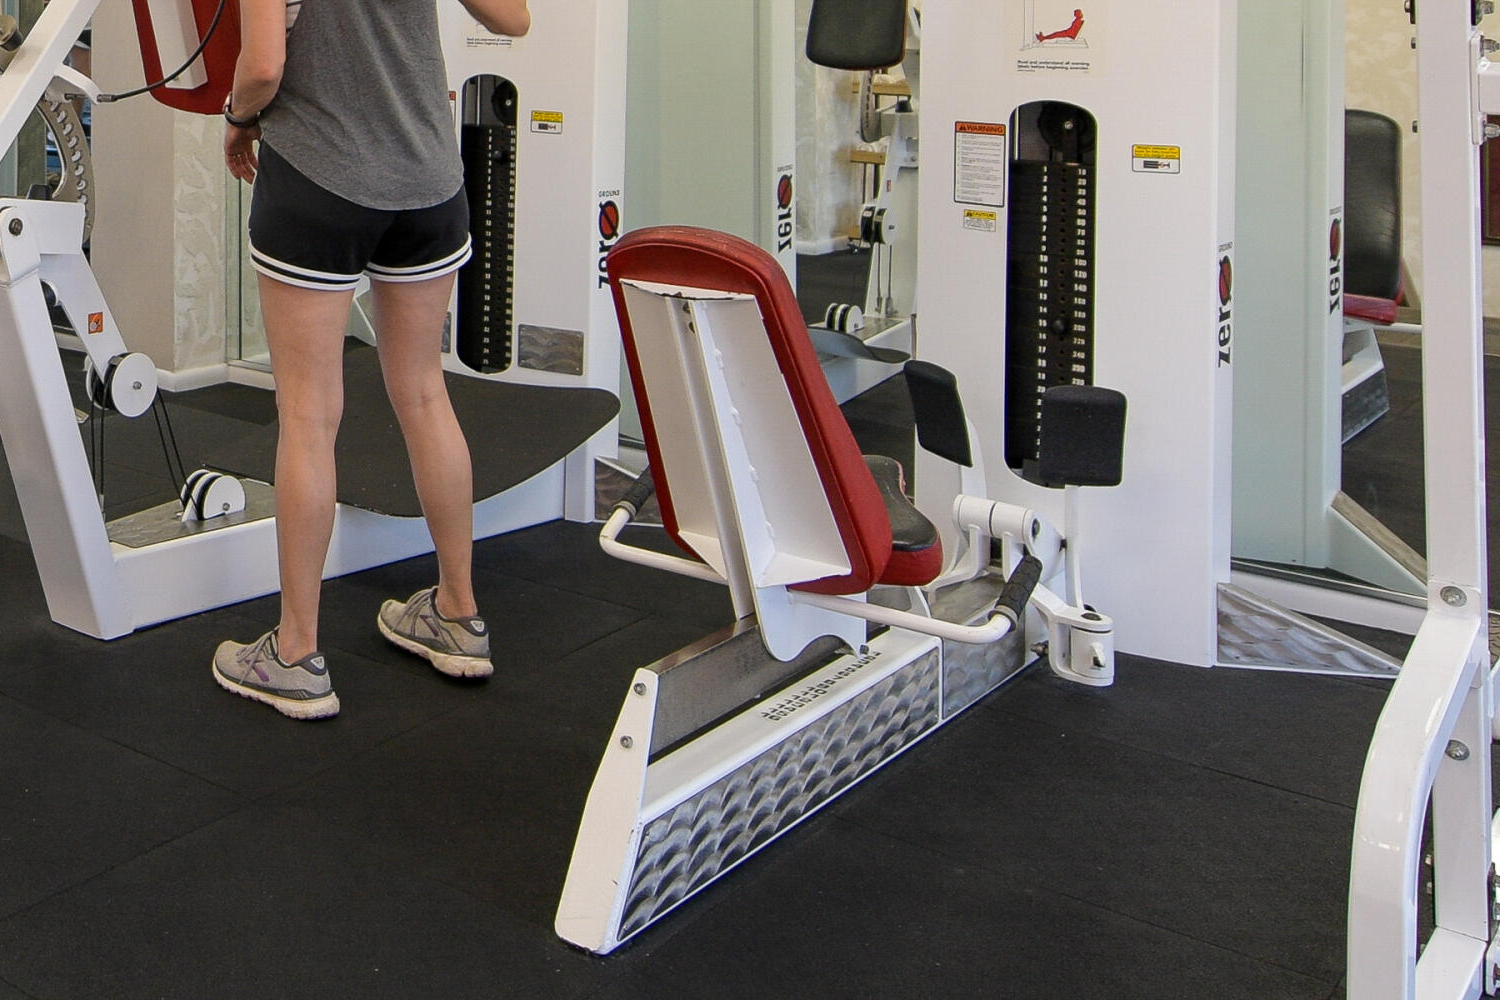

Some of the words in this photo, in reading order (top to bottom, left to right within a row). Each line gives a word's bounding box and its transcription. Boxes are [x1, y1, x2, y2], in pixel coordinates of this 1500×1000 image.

[966, 124, 1004, 134] WARNING
[1078, 168, 1087, 176] 10
[1074, 283, 1088, 293] 140
